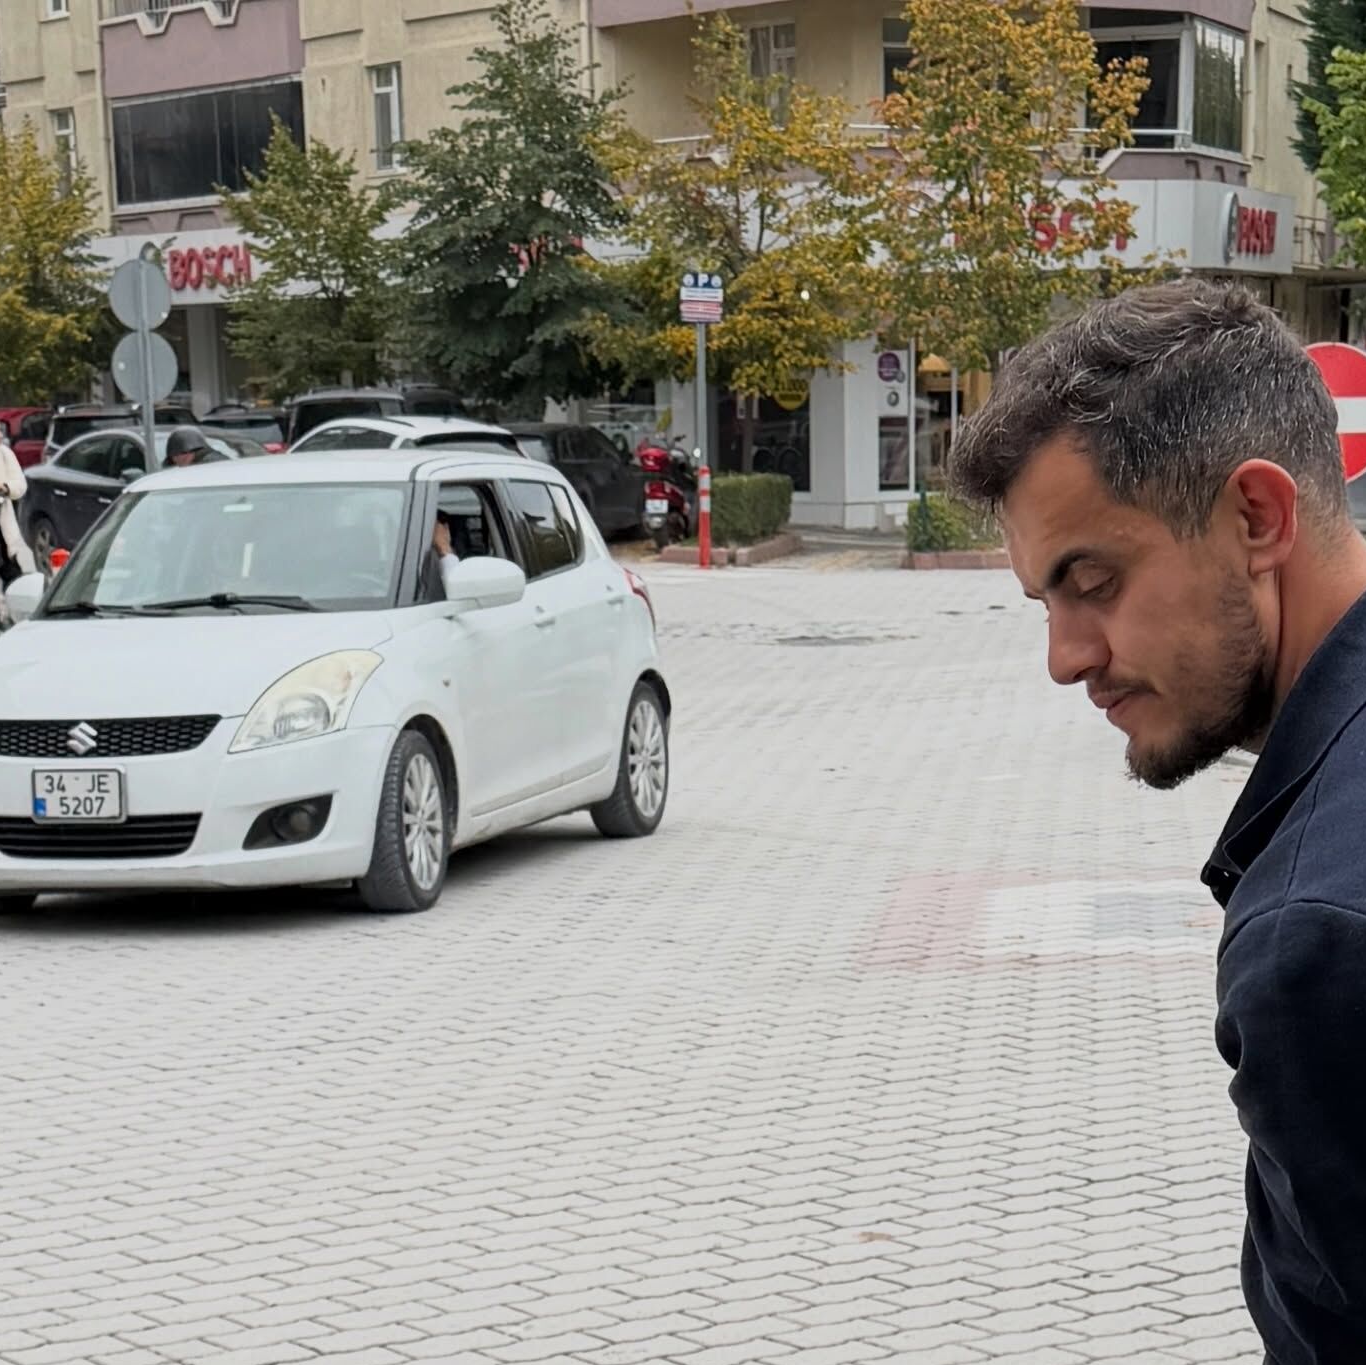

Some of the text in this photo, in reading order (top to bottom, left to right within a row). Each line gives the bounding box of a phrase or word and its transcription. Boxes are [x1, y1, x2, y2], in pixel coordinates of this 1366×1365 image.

[168, 245, 252, 291] BOSCH
[44, 773, 110, 793] 34 JE
[59, 796, 105, 816] 5207
